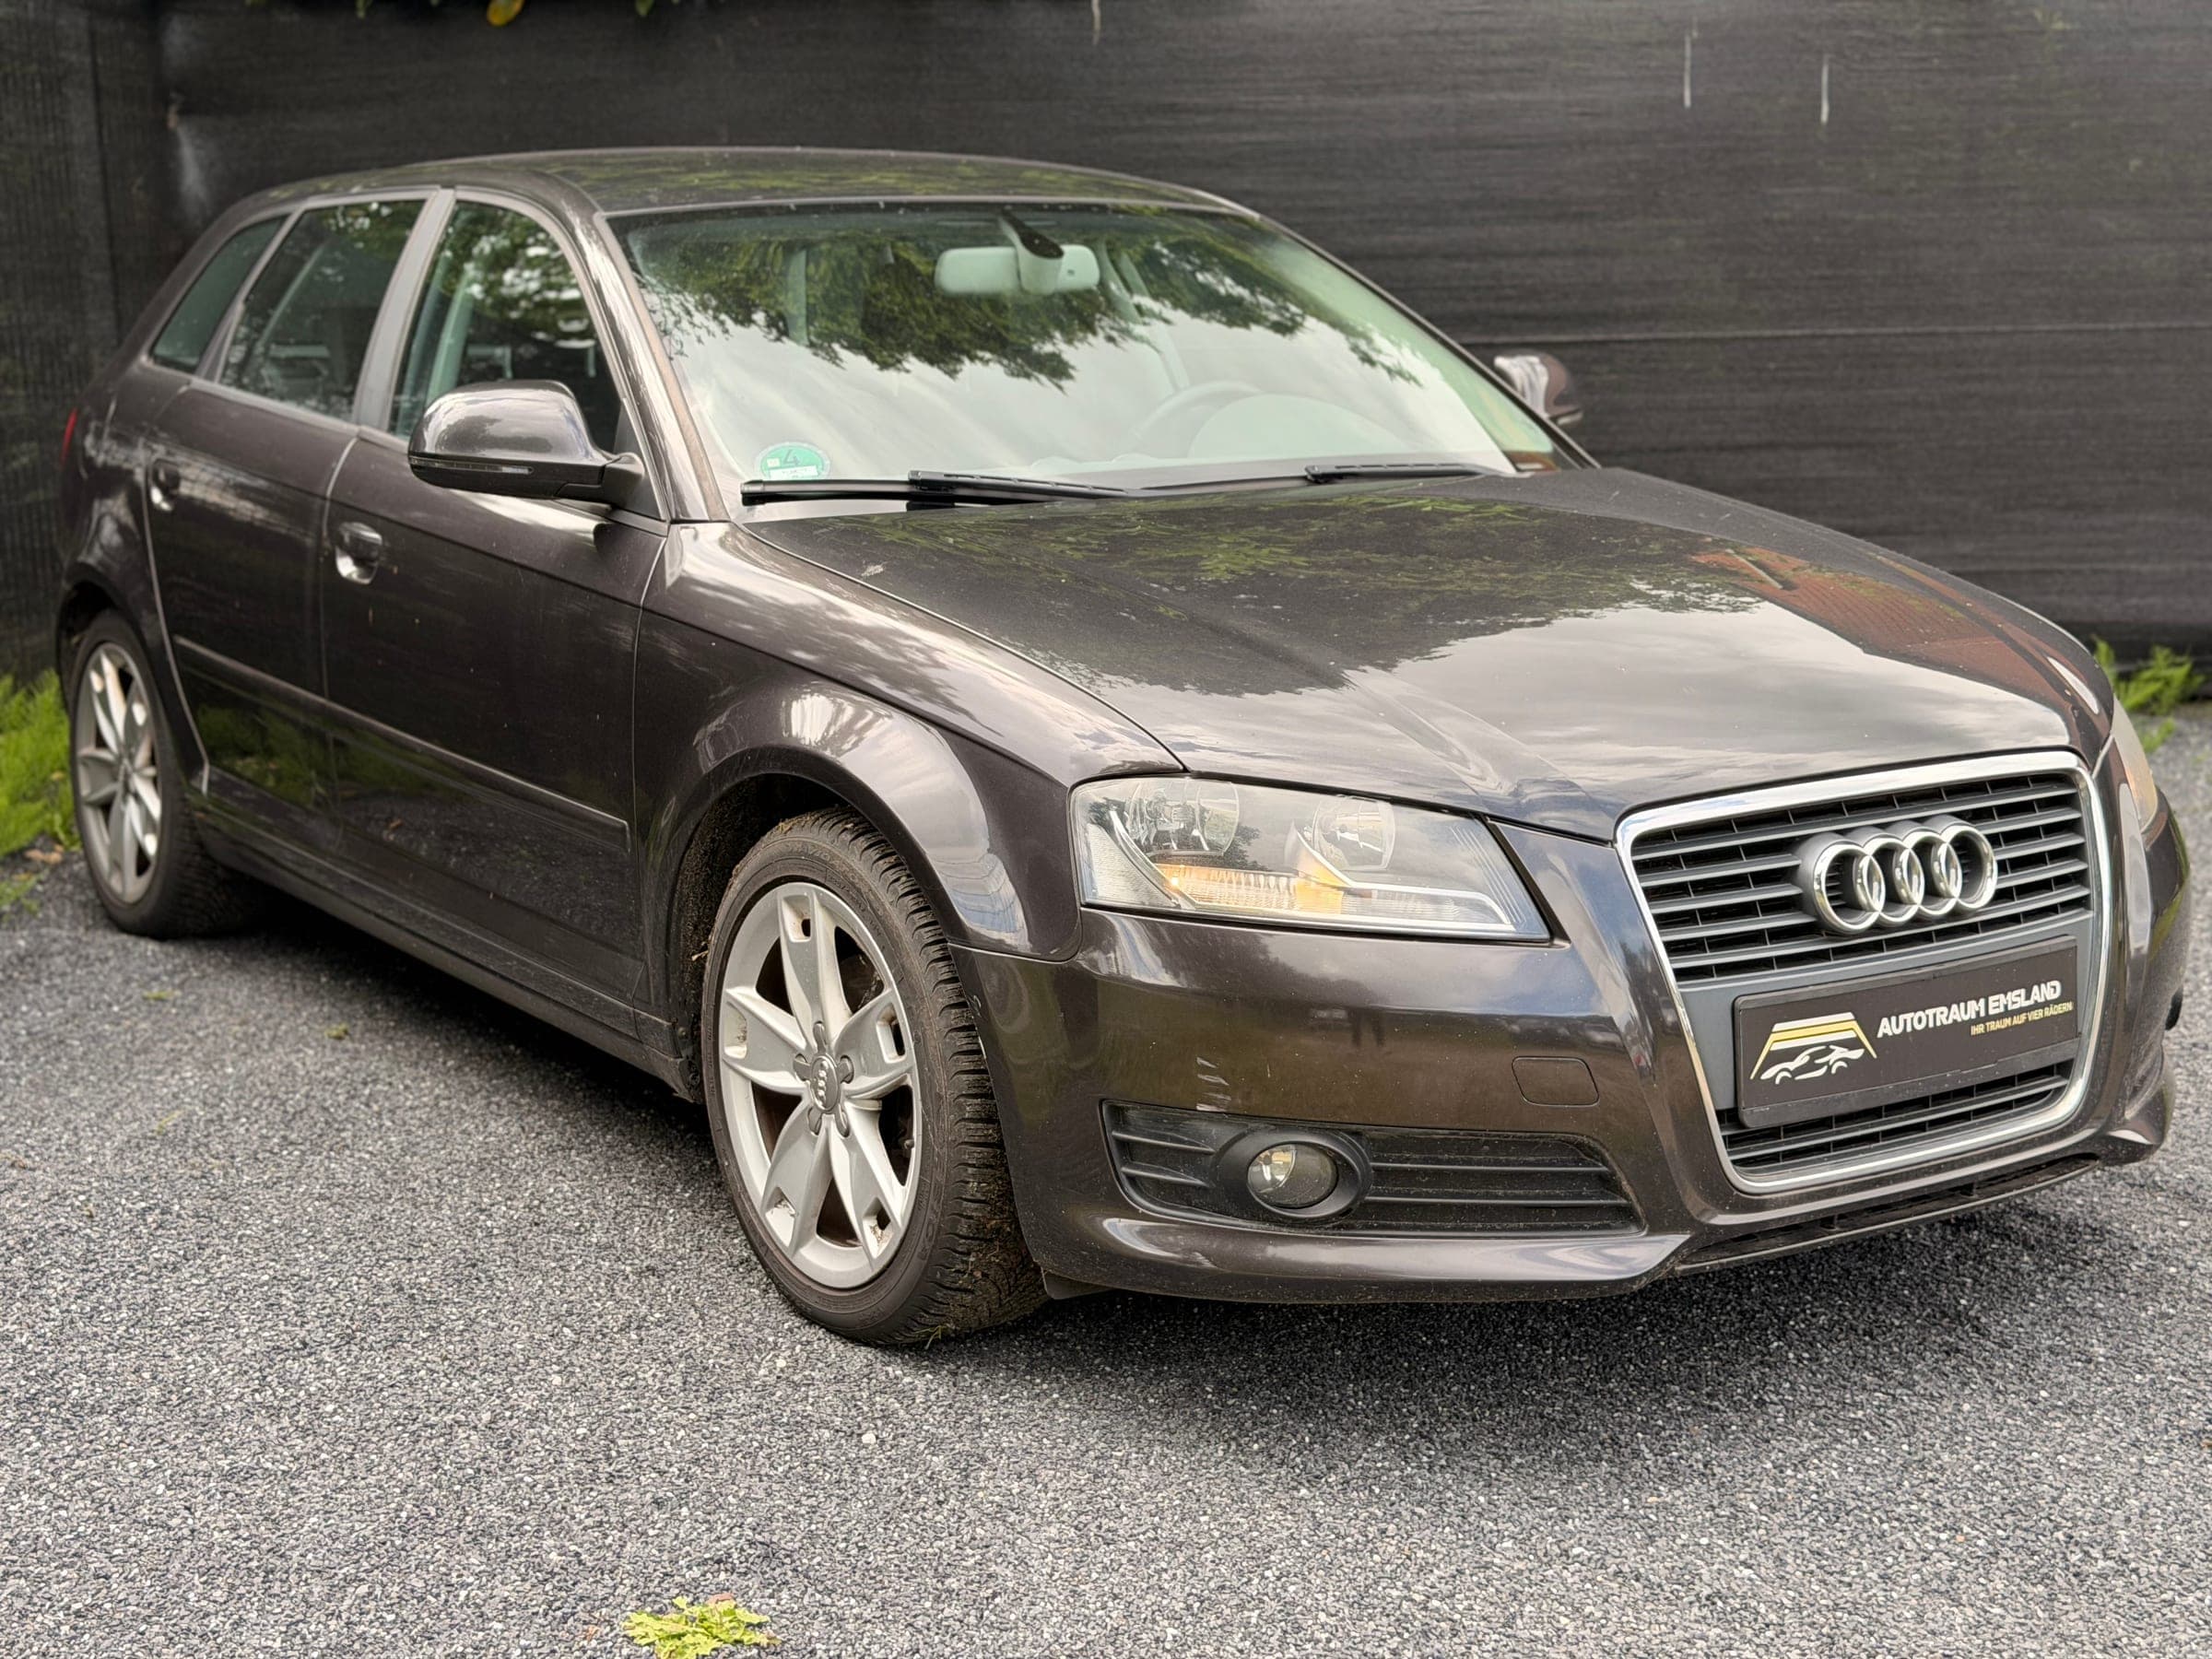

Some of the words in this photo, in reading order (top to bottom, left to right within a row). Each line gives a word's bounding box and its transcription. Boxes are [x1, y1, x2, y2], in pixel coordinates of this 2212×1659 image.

[783, 449, 800, 465] 4
[1877, 998, 1985, 1038] AUTOTRAUM
[1988, 981, 2061, 1015] EMSLAND
[1971, 1023, 1985, 1036] IHR
[1985, 1017, 2012, 1032] TRAUM
[2012, 1013, 2028, 1026] AUF
[2028, 1008, 2043, 1022] VIER
[2043, 1001, 2074, 1017] RÄDERN
